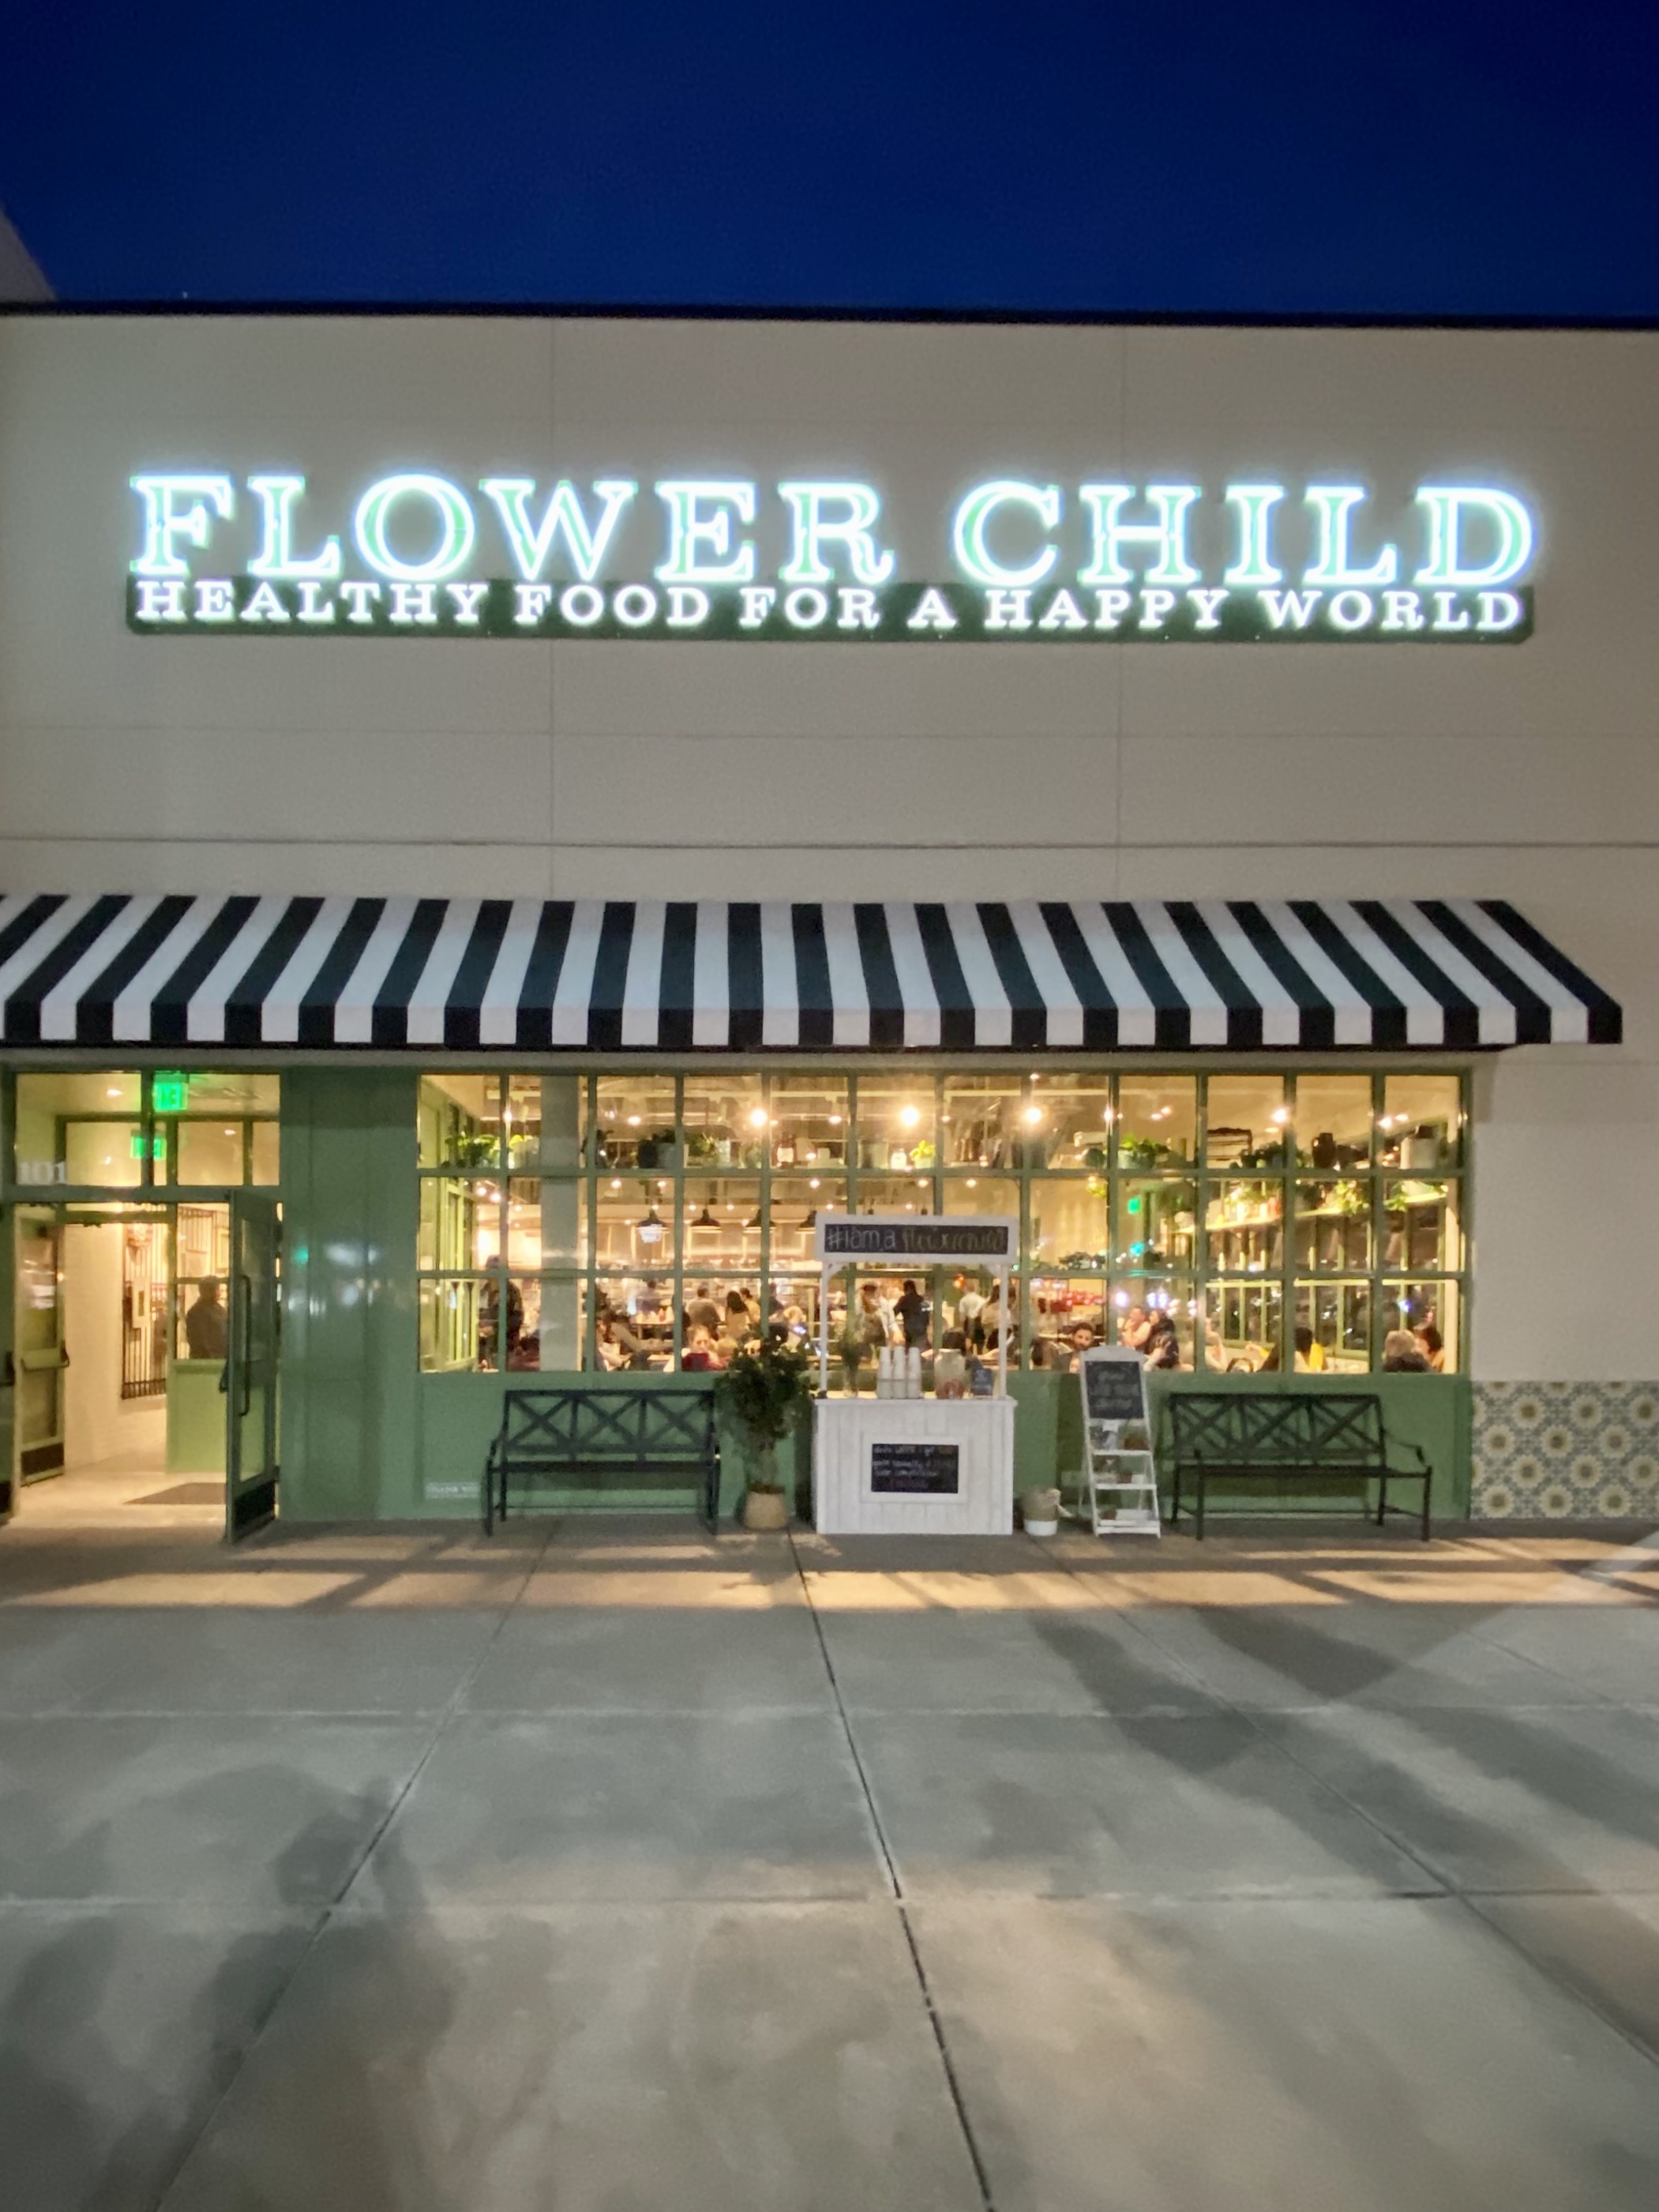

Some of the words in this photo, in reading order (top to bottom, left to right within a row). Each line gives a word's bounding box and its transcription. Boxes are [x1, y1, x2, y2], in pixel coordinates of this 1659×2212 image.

[130, 474, 895, 583] FLOWER
[954, 480, 1533, 586] CHILD
[136, 580, 487, 624] HEALTHY
[514, 584, 709, 627] FOOD
[739, 587, 880, 629] FOR
[907, 588, 957, 629] A
[984, 589, 1229, 630] HAPPY
[1257, 590, 1523, 632] WORLD
